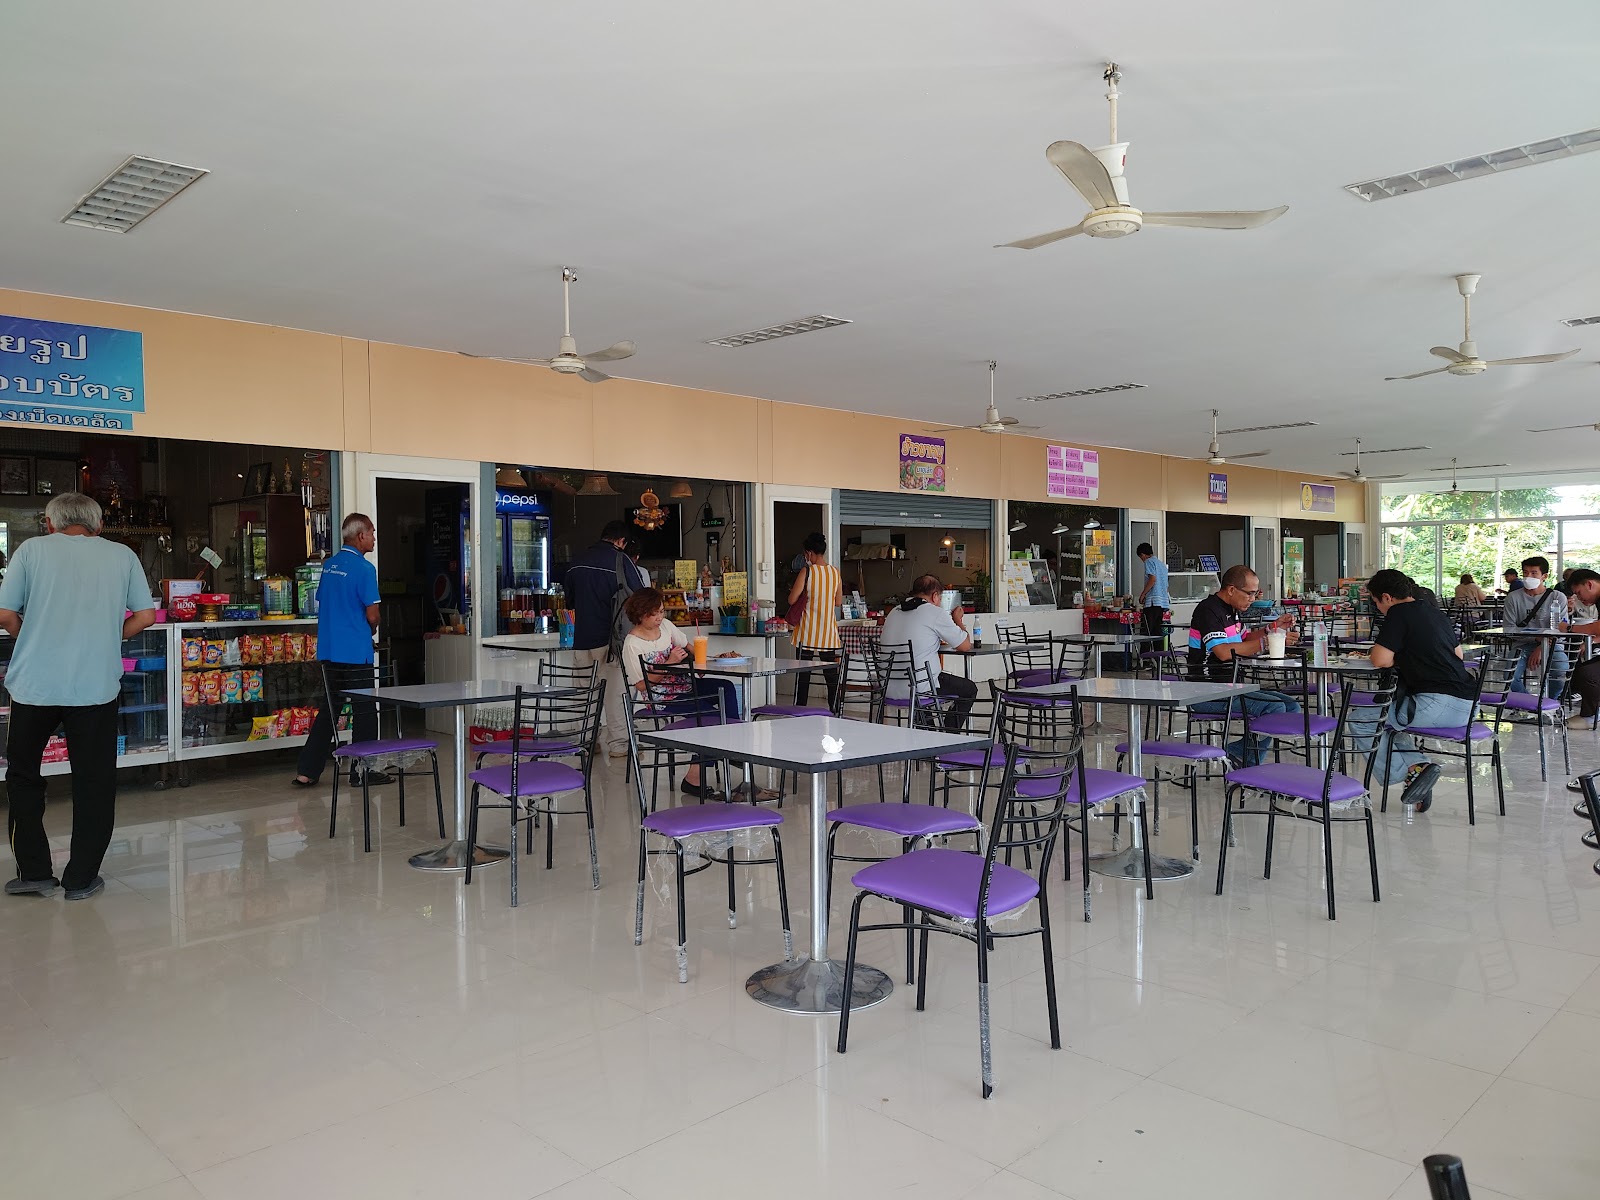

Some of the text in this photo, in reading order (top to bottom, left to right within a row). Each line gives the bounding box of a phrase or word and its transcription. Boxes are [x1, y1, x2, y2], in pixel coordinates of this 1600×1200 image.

[0, 335, 87, 364] ยรูป
[0, 408, 122, 429] งเบ็ดเตล็ด
[901, 437, 944, 464] ข้าวขาหมู
[502, 494, 538, 506] pepsi
